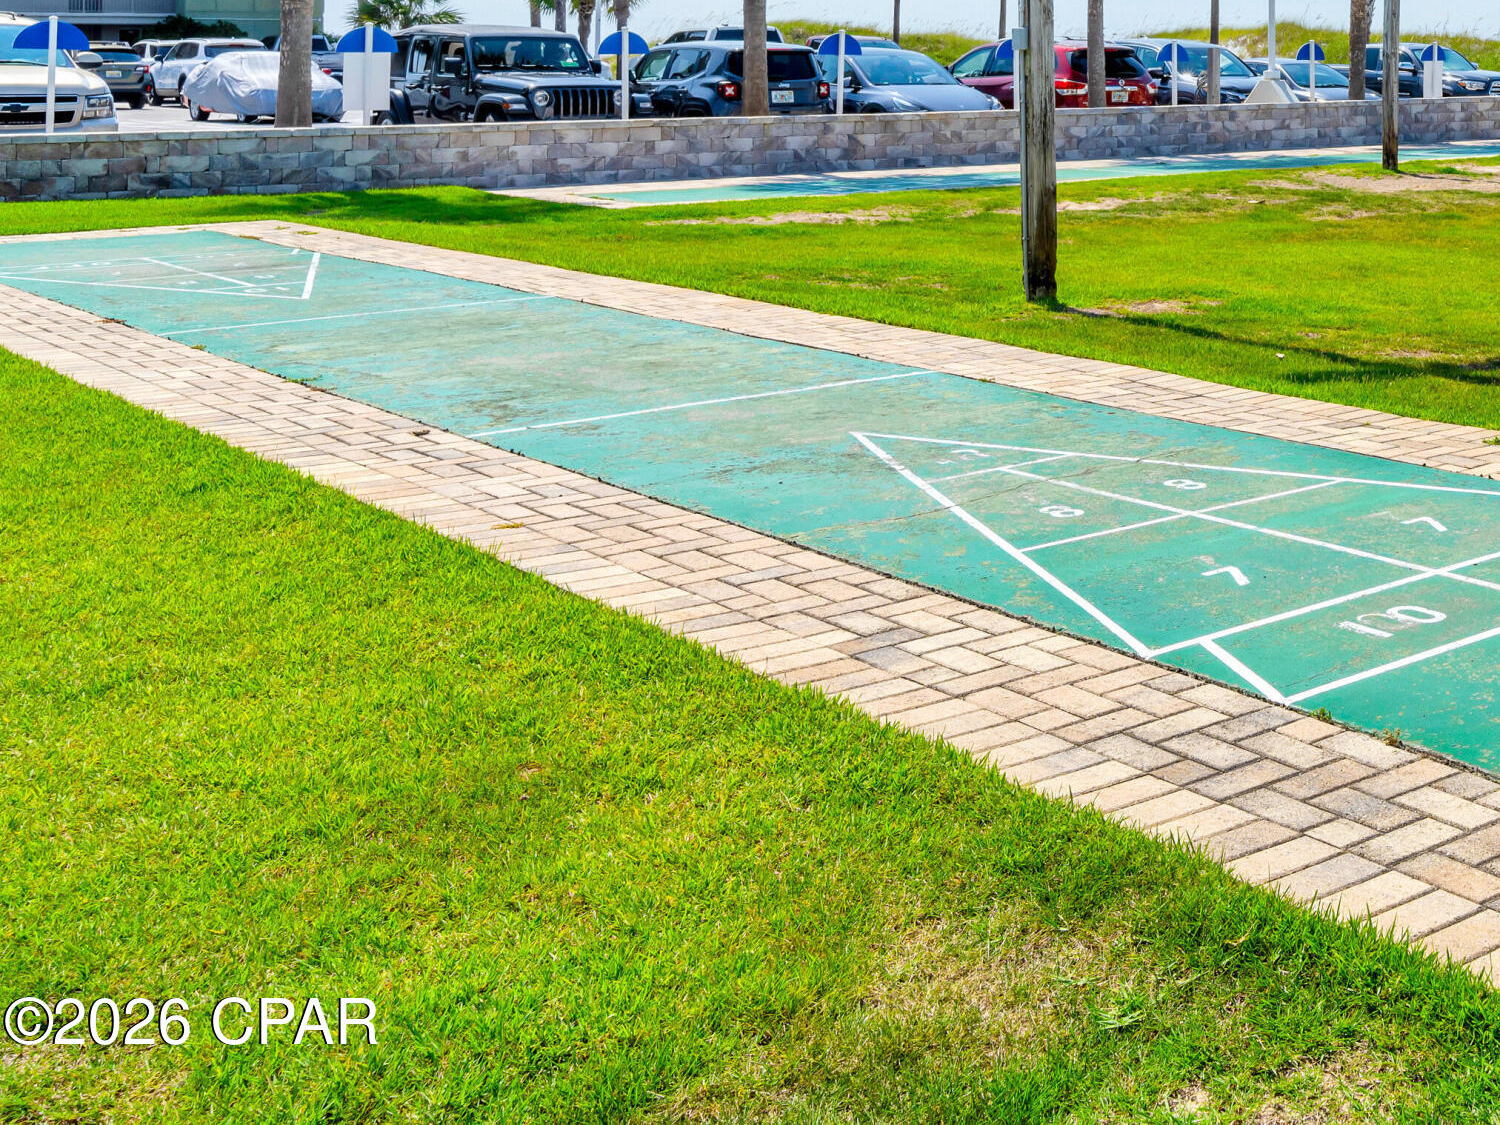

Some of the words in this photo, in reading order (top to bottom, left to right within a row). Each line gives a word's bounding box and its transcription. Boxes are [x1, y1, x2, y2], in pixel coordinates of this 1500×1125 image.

[1162, 479, 1207, 490] 8
[1039, 505, 1085, 518] 8
[1400, 516, 1448, 532] 7
[1201, 565, 1250, 586] 7
